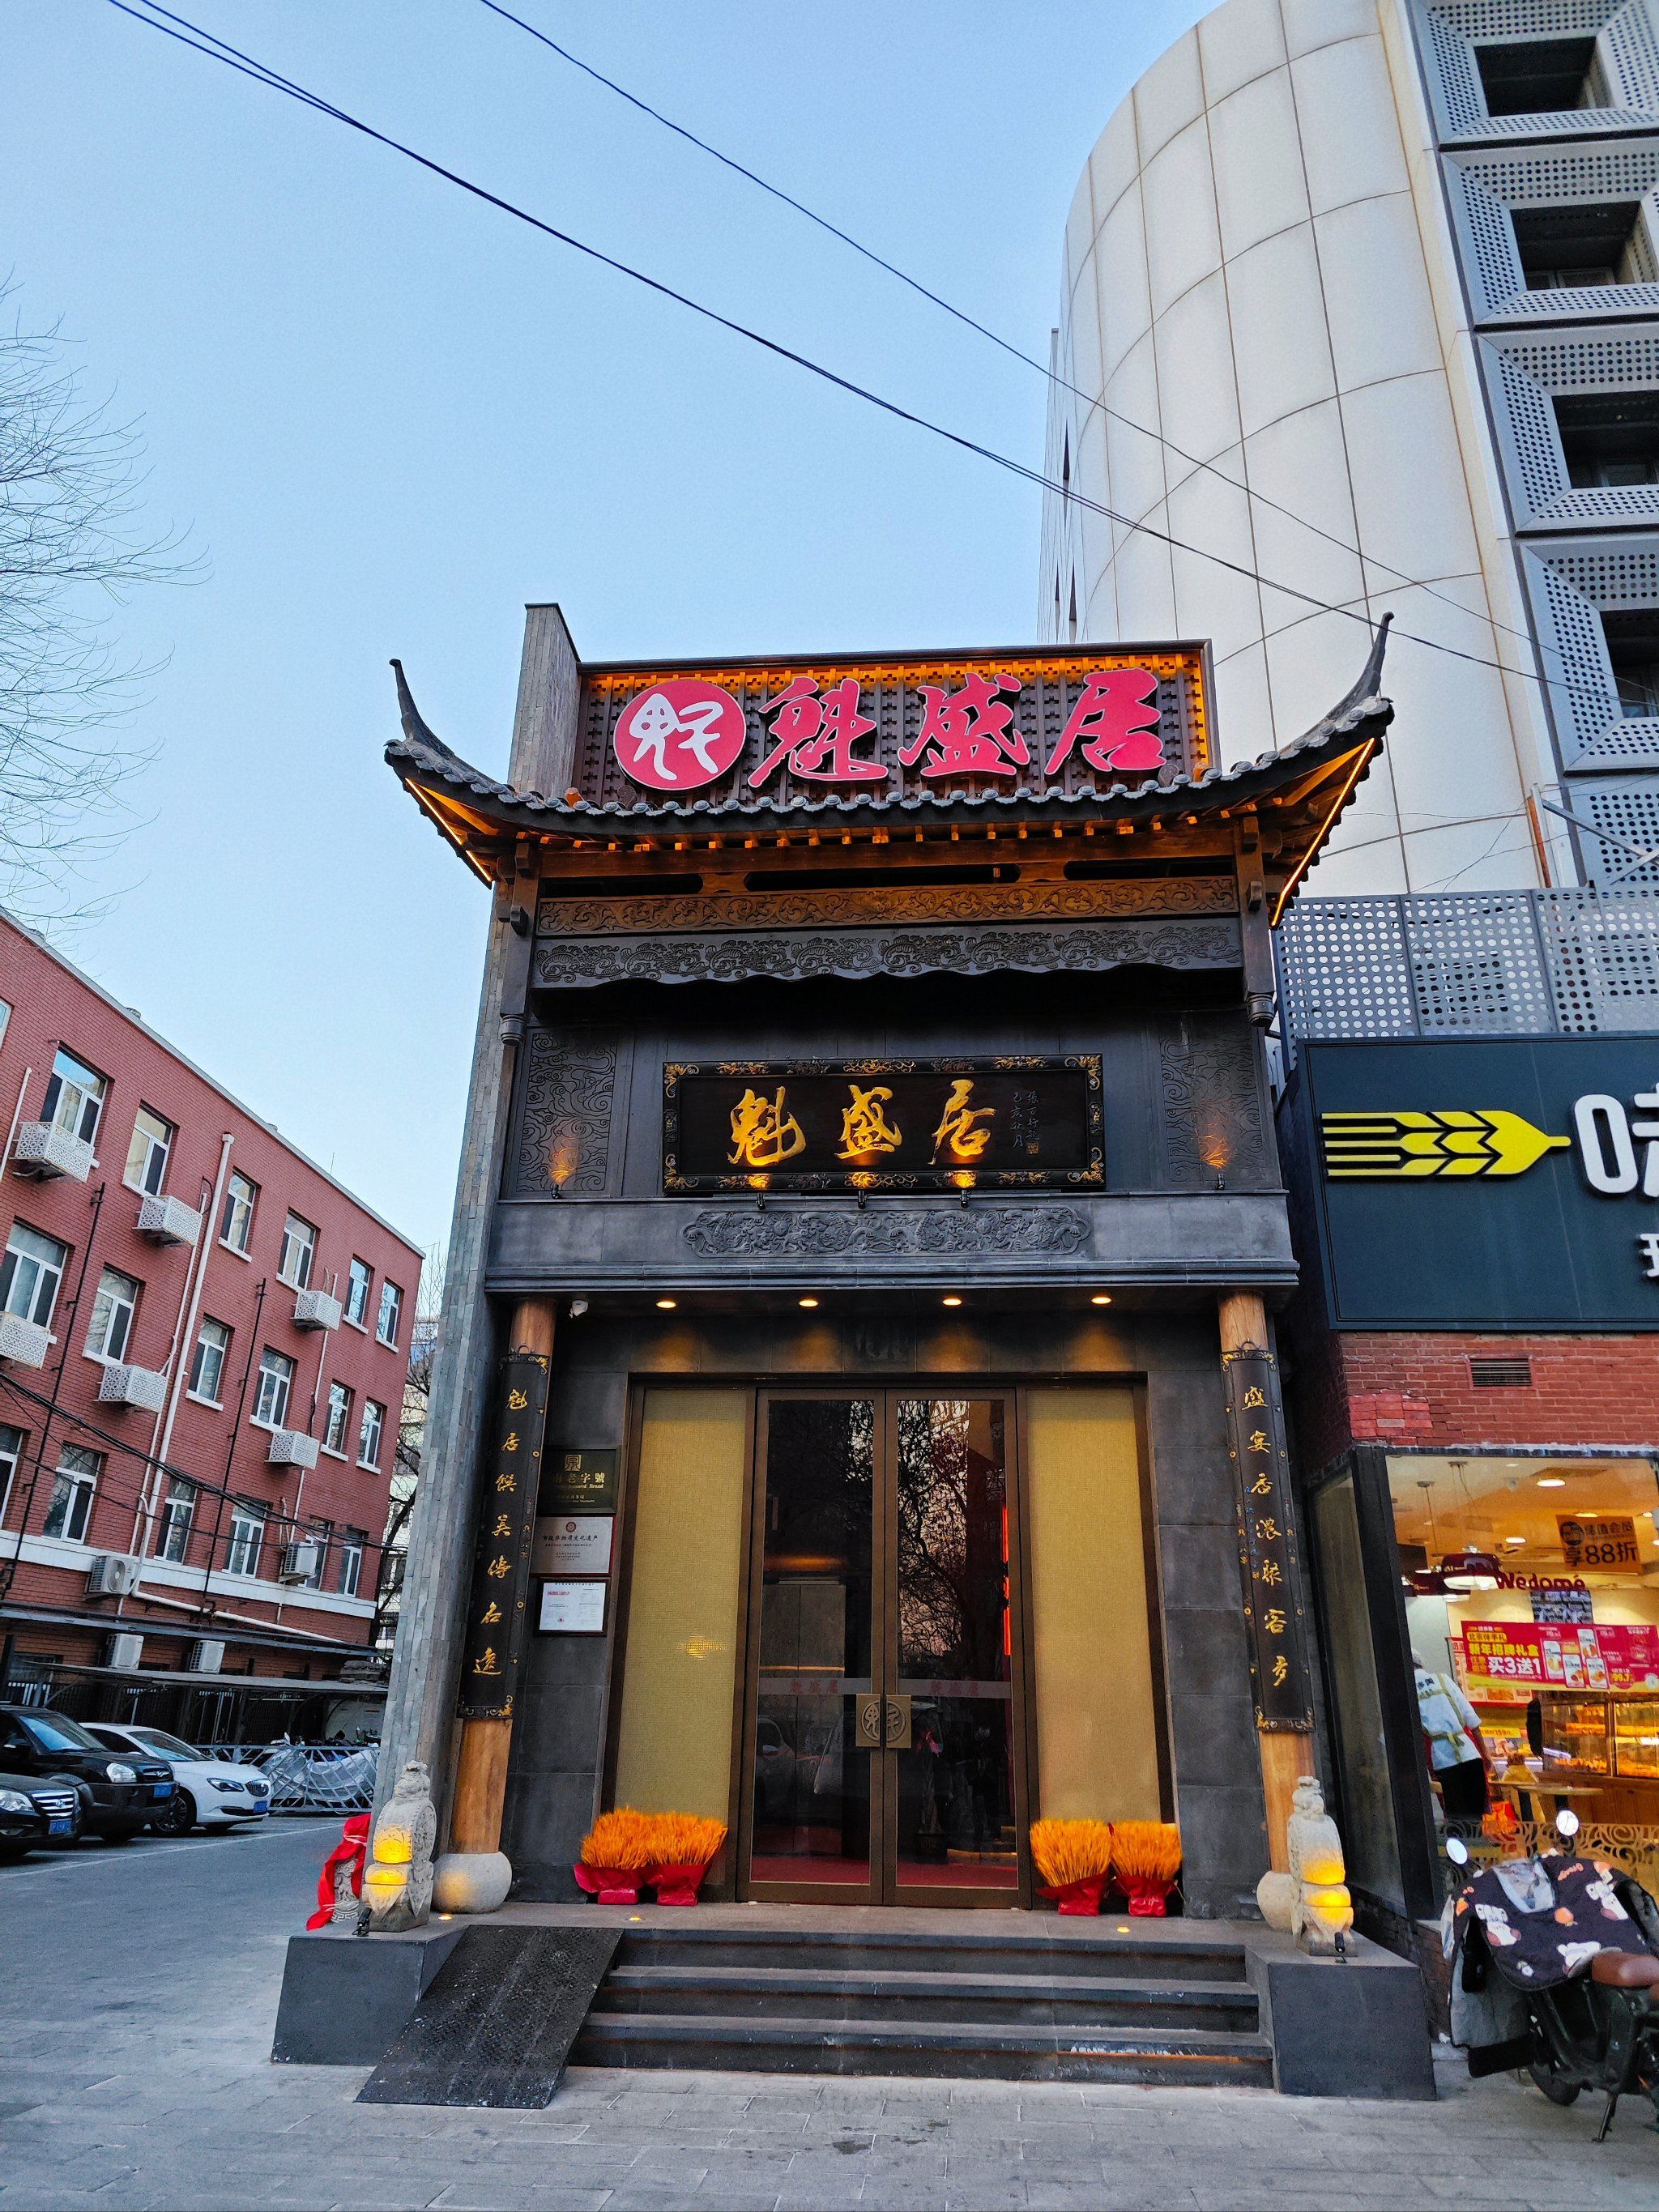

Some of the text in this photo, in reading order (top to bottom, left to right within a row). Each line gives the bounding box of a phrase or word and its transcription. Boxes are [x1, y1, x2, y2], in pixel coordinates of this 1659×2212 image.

[748, 667, 1168, 788] 魁盛居
[727, 1079, 996, 1167] 魁盛居
[1566, 1542, 1638, 1566] 享88折
[1488, 1656, 1541, 1674] 买3送1
